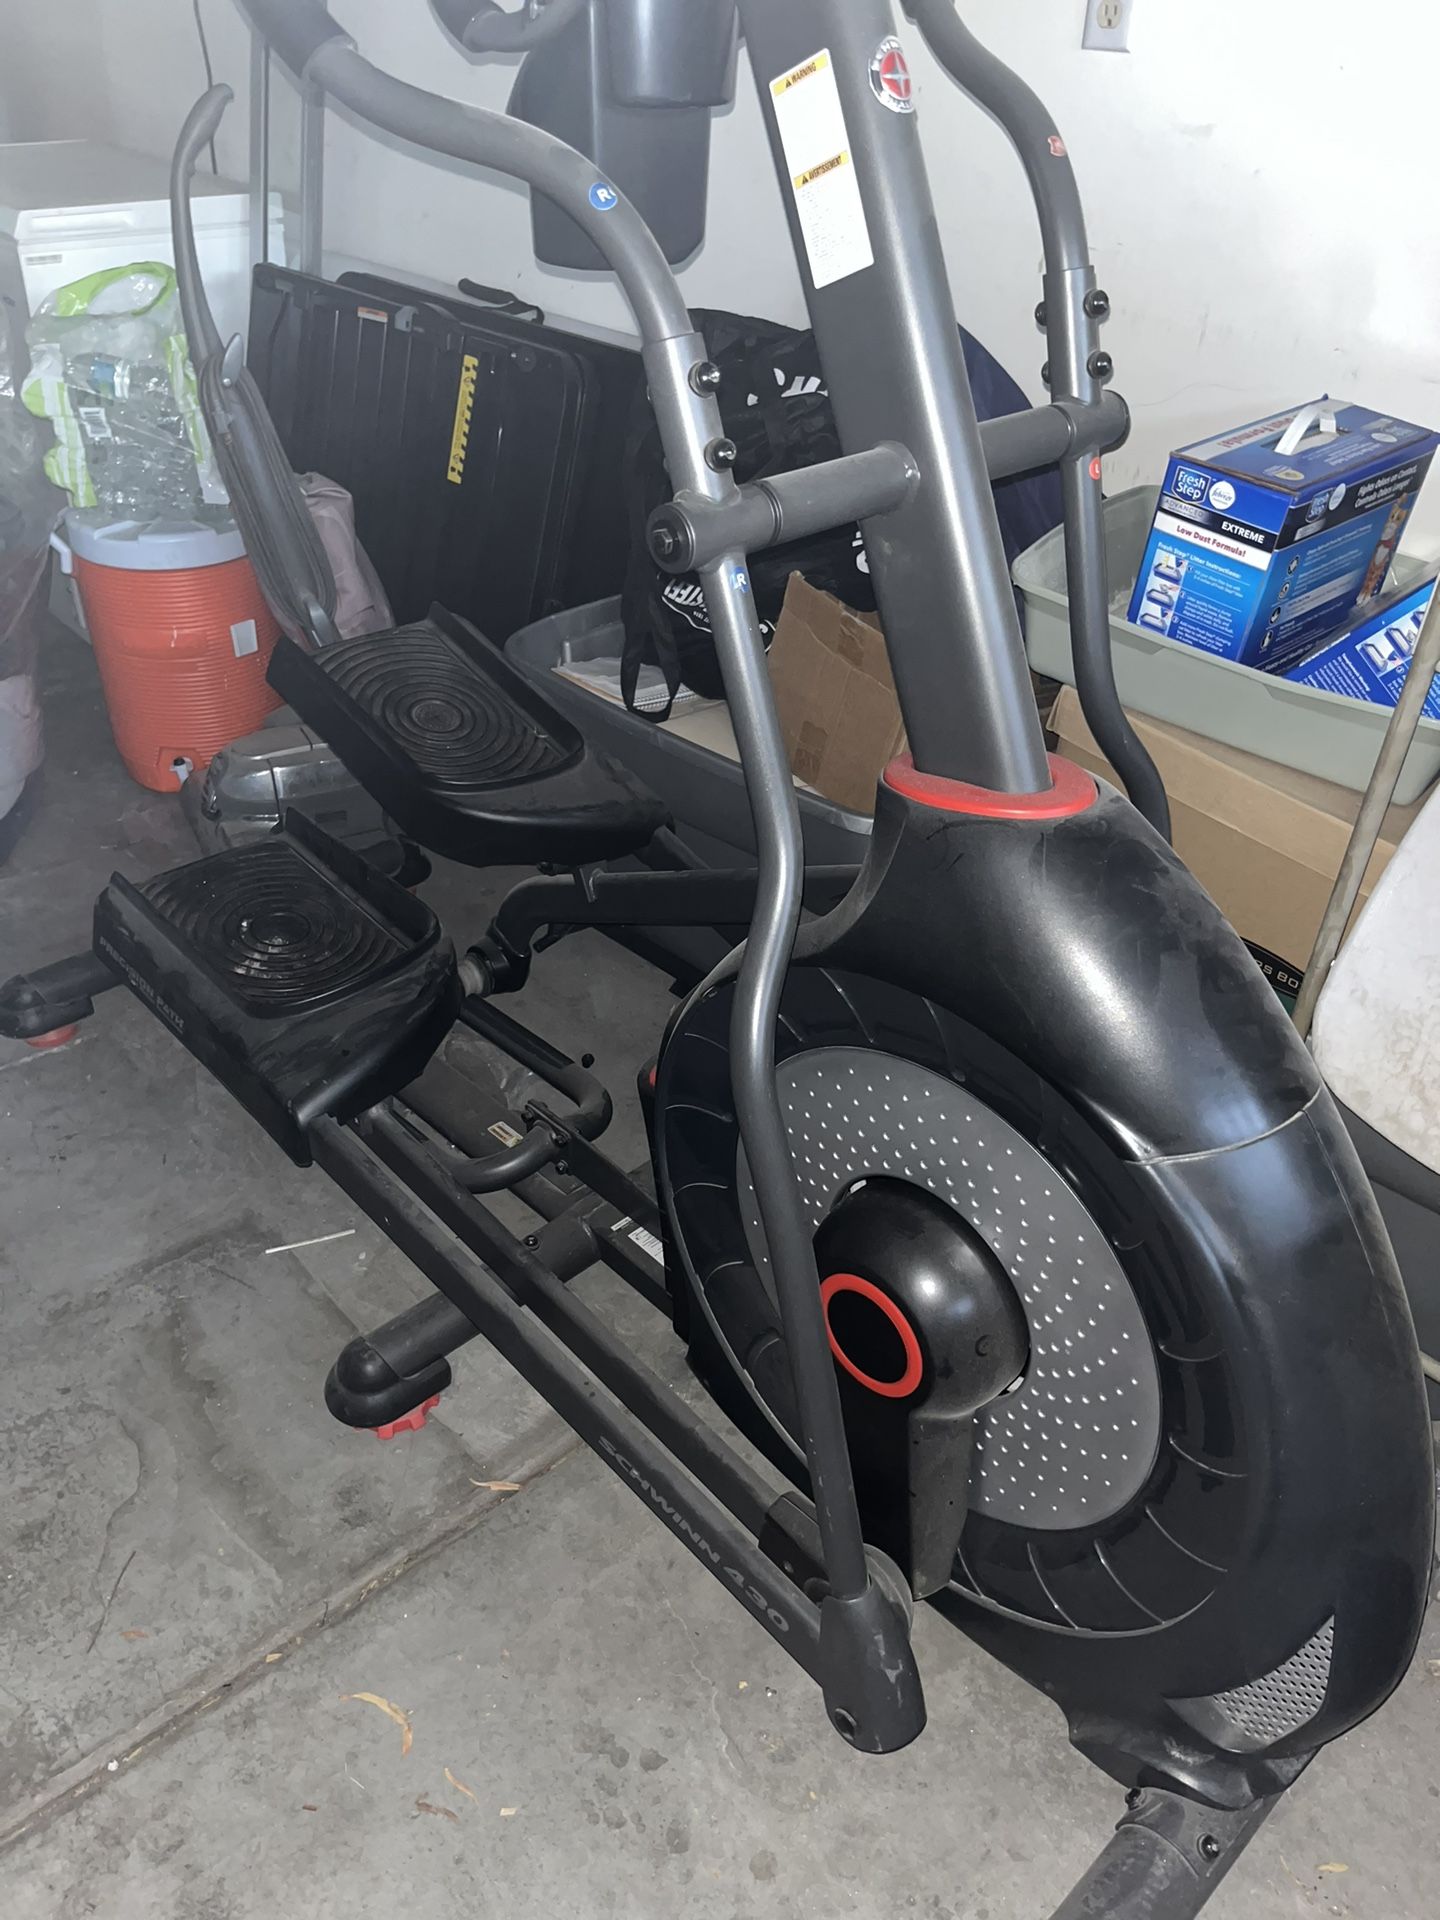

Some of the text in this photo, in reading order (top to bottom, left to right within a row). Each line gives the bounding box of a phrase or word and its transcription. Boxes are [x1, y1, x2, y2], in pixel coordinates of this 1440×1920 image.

[792, 62, 816, 83] WARNING
[808, 155, 842, 179] AVERTISSEMENT
[1176, 482, 1201, 500] Step
[1178, 470, 1206, 490] Fresh
[1176, 525, 1246, 557] Low Dust Formula!
[1221, 521, 1265, 544] EXTREME
[598, 1436, 790, 1632] SCHWINN 430
